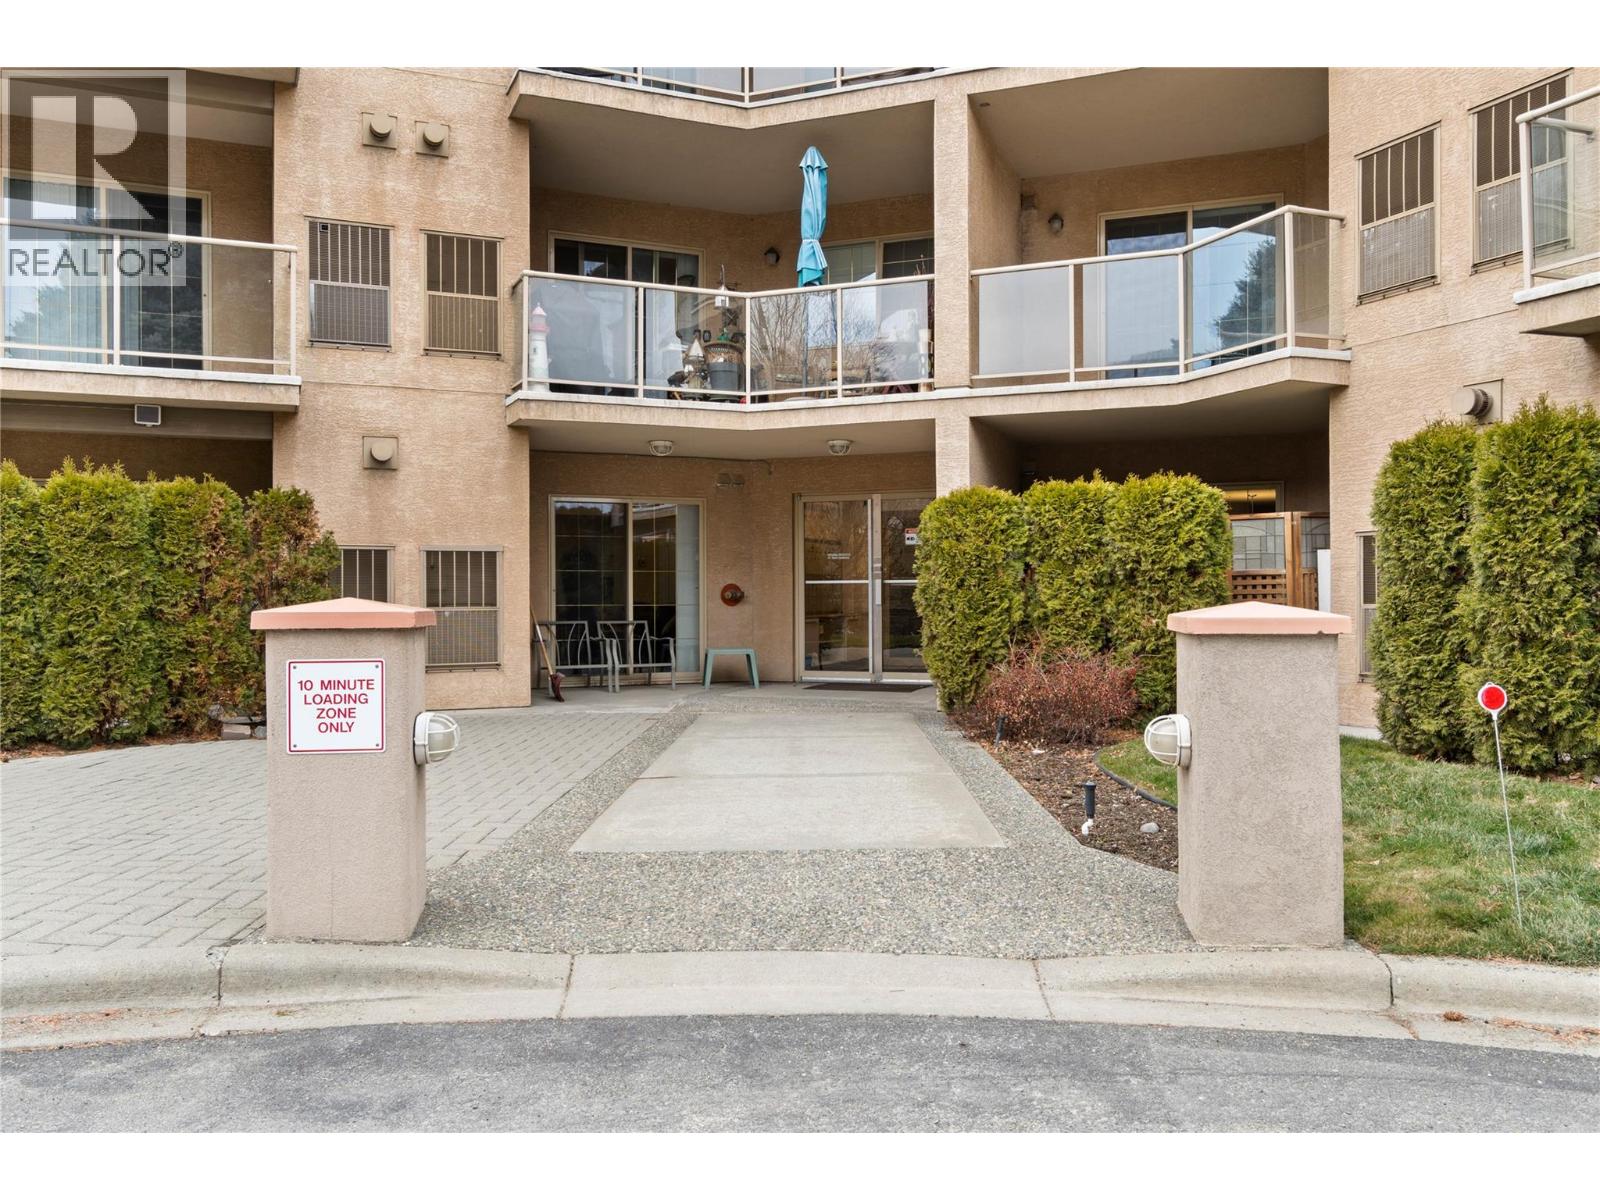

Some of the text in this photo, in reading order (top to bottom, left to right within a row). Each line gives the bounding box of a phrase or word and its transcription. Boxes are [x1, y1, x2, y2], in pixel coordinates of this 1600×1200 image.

[297, 679, 375, 691] 10 MINUTE
[304, 693, 369, 705] LOADING
[316, 707, 357, 719] ZONE
[318, 721, 355, 733] ONLY
